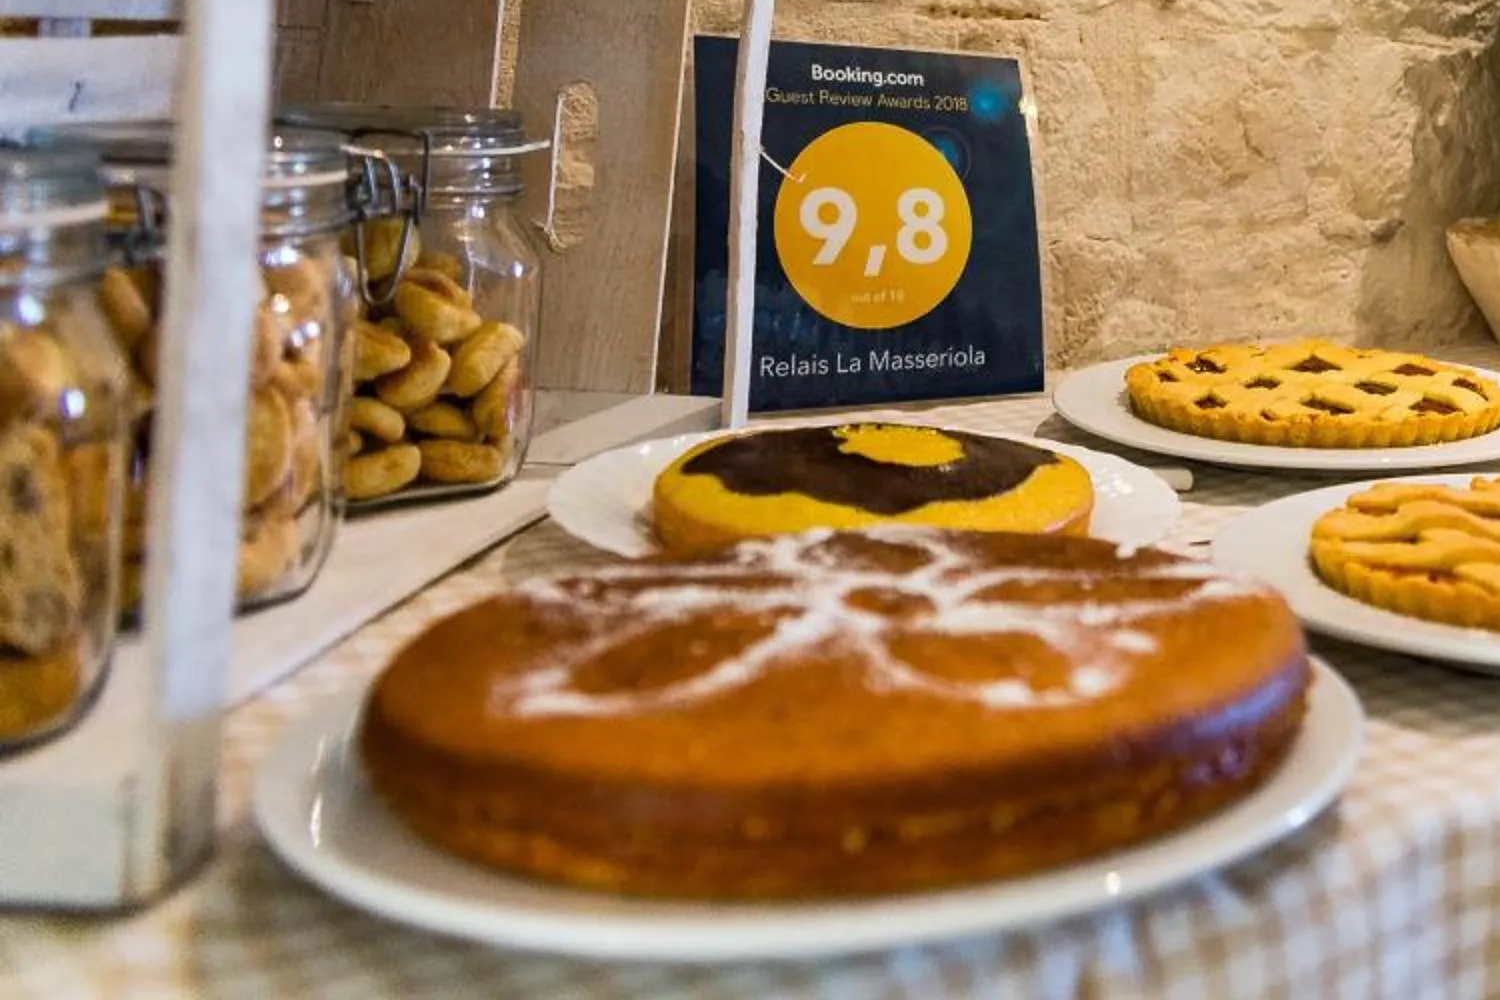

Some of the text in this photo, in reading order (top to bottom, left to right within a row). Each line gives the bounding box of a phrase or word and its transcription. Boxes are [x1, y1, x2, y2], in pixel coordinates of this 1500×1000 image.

[811, 64, 925, 87] Booking.com
[765, 87, 969, 111] Guest Review Awards 2018
[799, 187, 949, 277] 9,8
[759, 344, 986, 377] Relais La Masseriola
